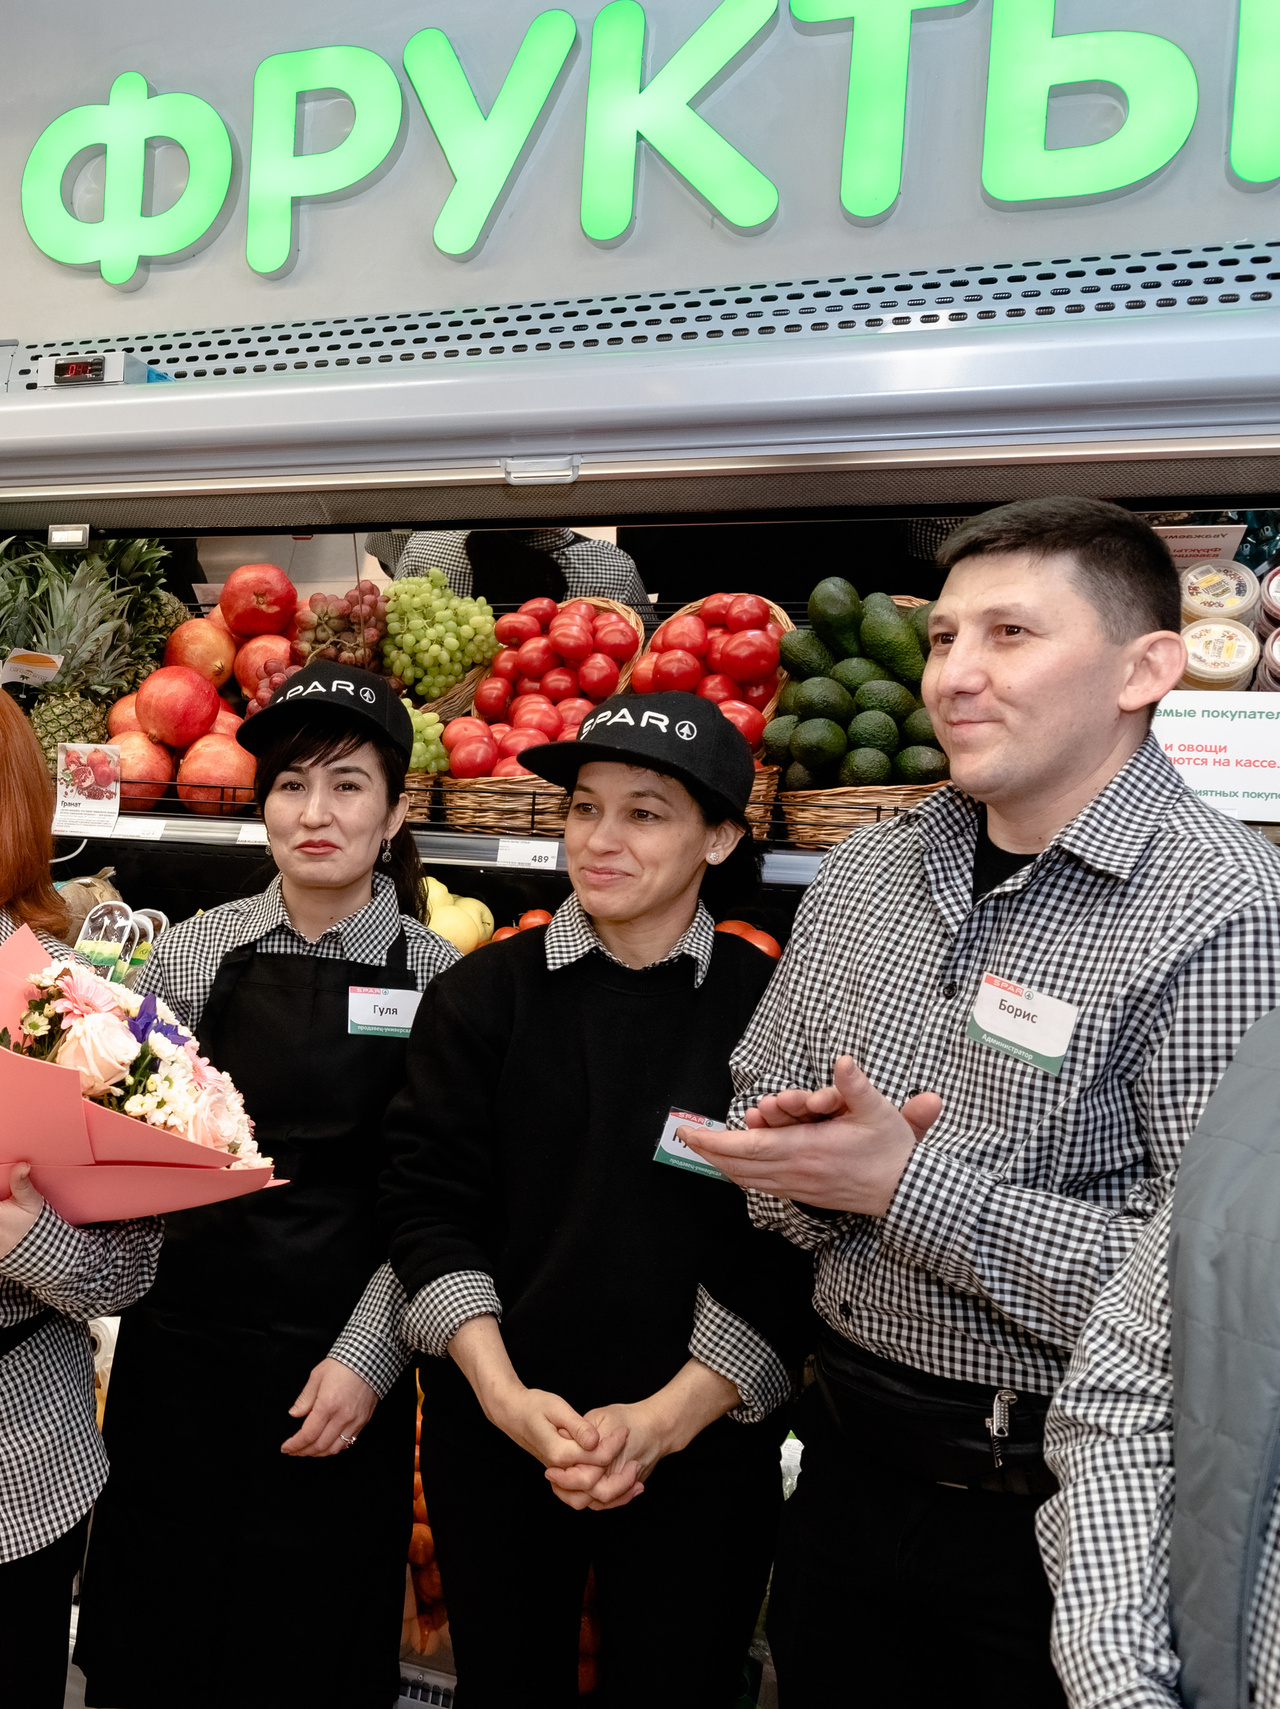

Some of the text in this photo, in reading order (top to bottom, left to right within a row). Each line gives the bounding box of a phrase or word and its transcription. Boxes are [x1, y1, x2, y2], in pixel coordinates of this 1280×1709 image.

[21, 0, 1280, 286] ФРУКТЫ
[1155, 708, 1197, 718] емые
[580, 708, 669, 740] SPAR
[1164, 743, 1227, 754] и овощи
[1213, 758, 1230, 767] на
[1235, 759, 1280, 768] кассе.
[531, 855, 549, 863] 489
[993, 979, 1023, 996] SPAR
[373, 1005, 398, 1016] Гуля
[998, 998, 1038, 1024] Борис
[982, 1033, 1033, 1060] Администратор
[678, 1112, 705, 1124] SPAR
